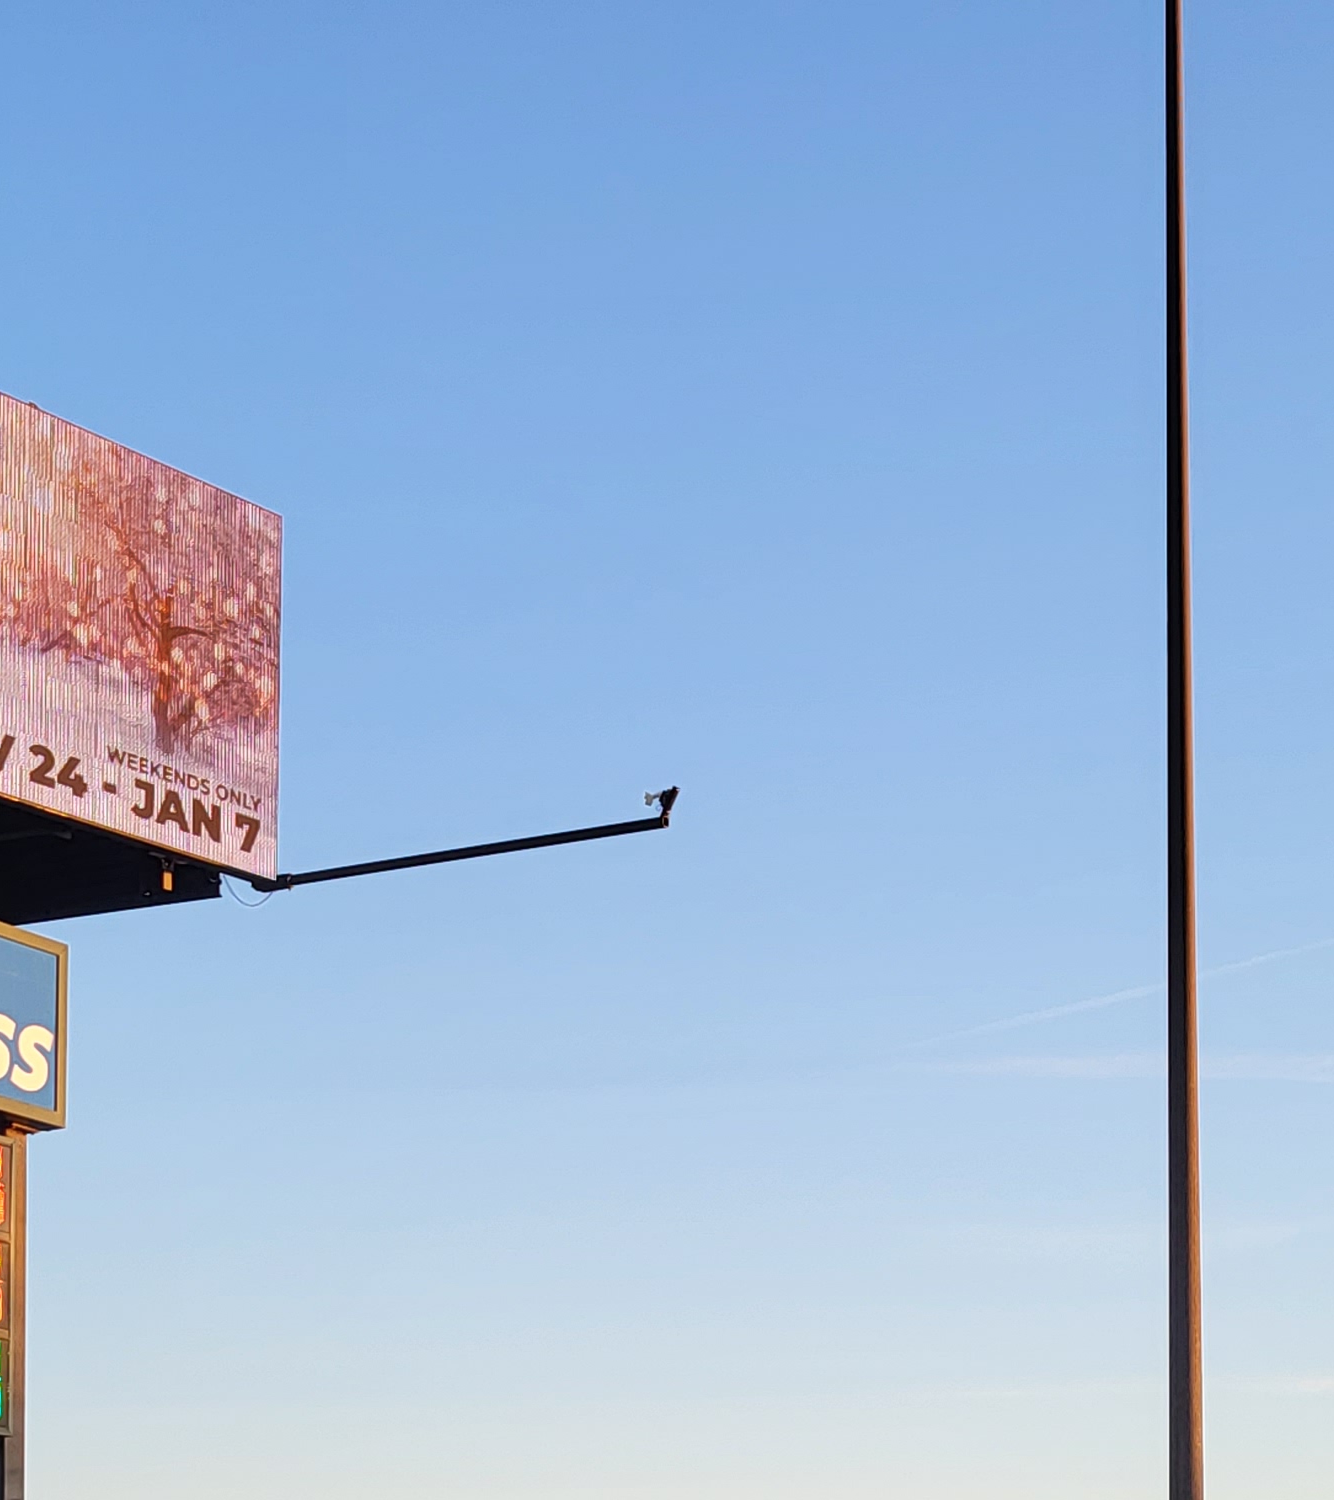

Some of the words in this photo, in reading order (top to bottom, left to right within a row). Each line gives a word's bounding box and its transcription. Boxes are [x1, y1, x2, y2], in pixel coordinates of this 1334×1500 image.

[28, 744, 87, 796] 24
[131, 777, 222, 844] JAN
[235, 812, 261, 854] 7
[105, 745, 210, 796] WEEKENDS
[216, 784, 262, 813] ONLY
